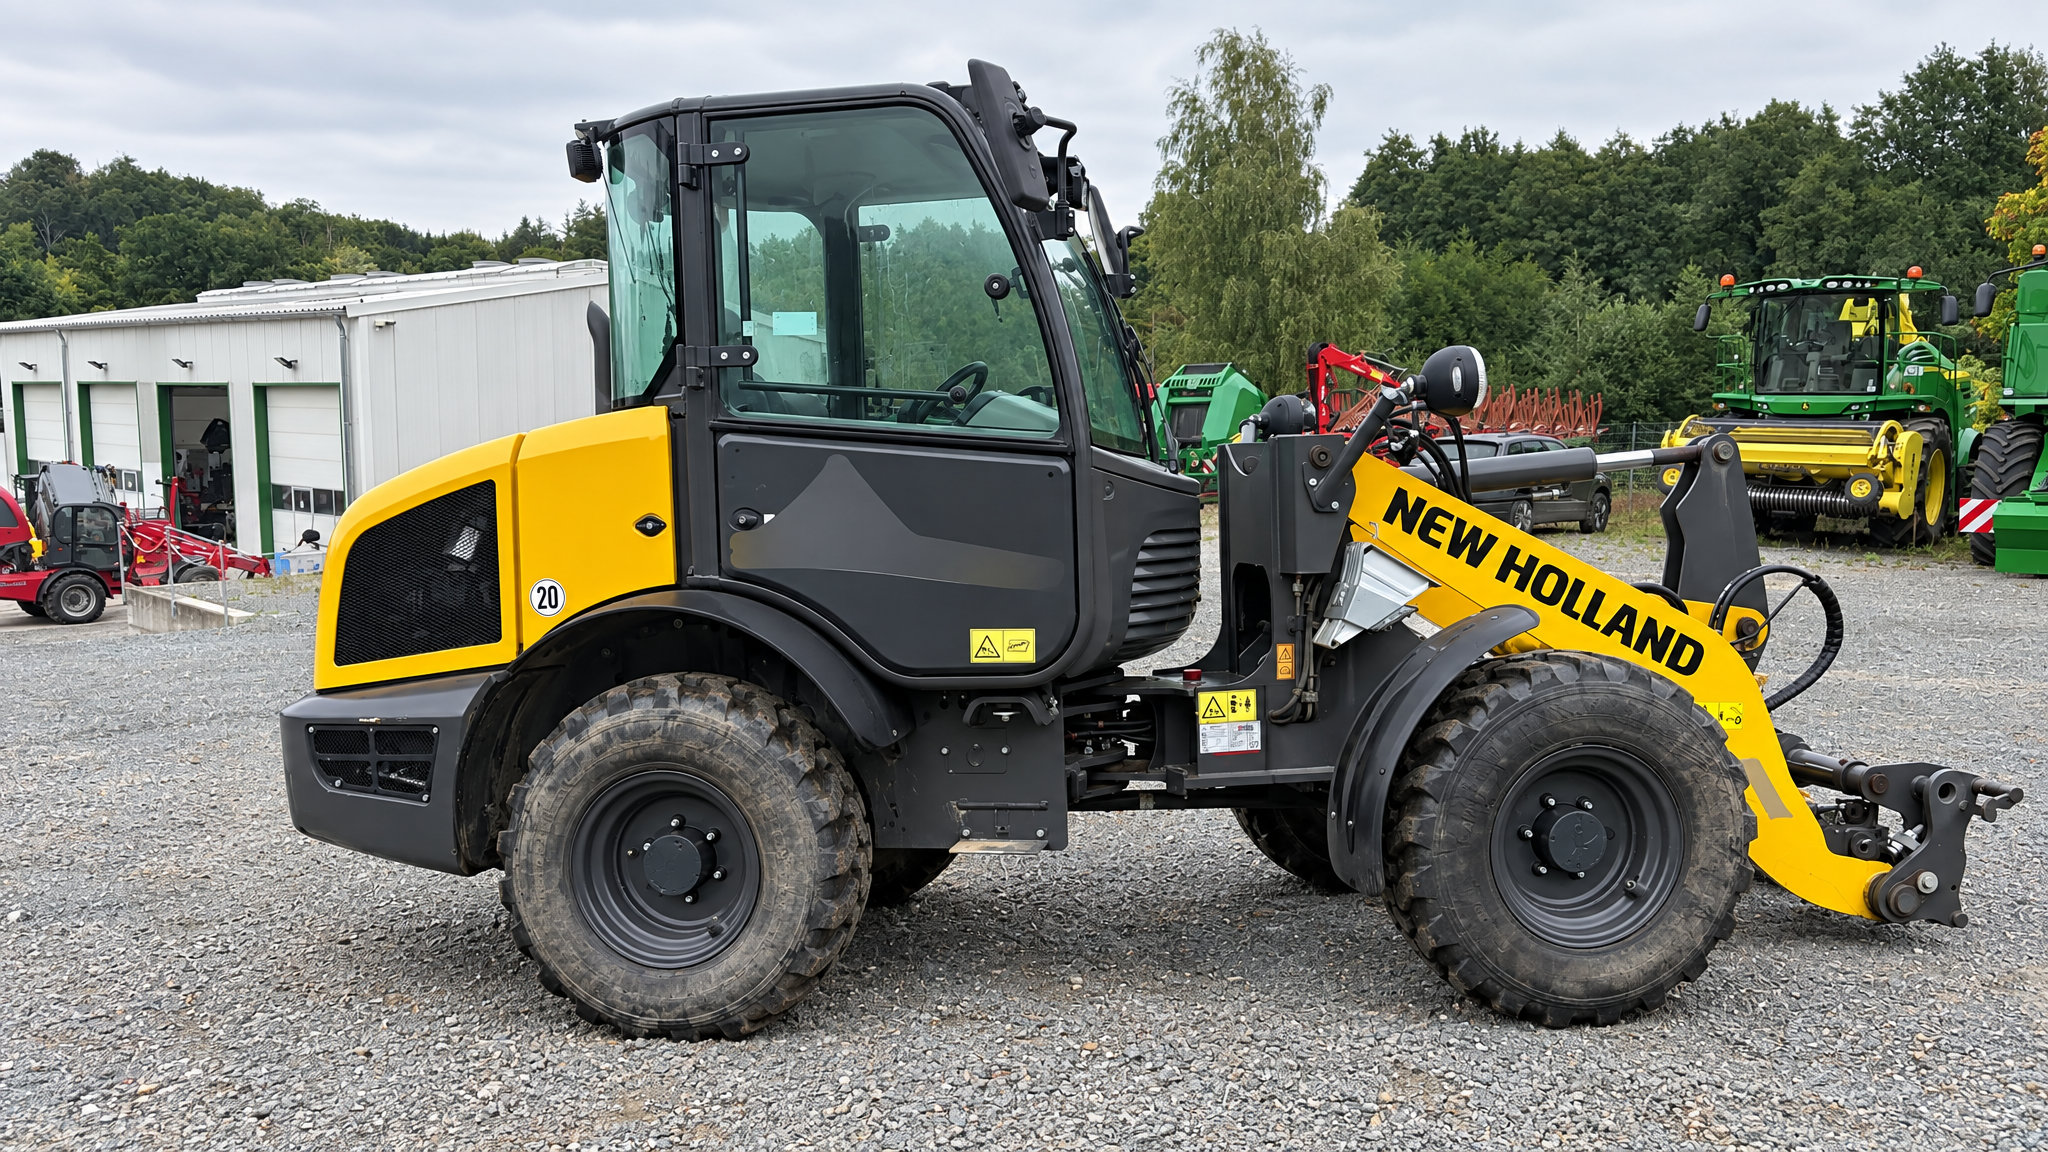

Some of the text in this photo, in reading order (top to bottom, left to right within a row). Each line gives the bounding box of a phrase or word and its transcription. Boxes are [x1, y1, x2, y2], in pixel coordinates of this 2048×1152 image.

[536, 586, 559, 610] 20
[1383, 487, 1705, 676] NEW HOLLAND
